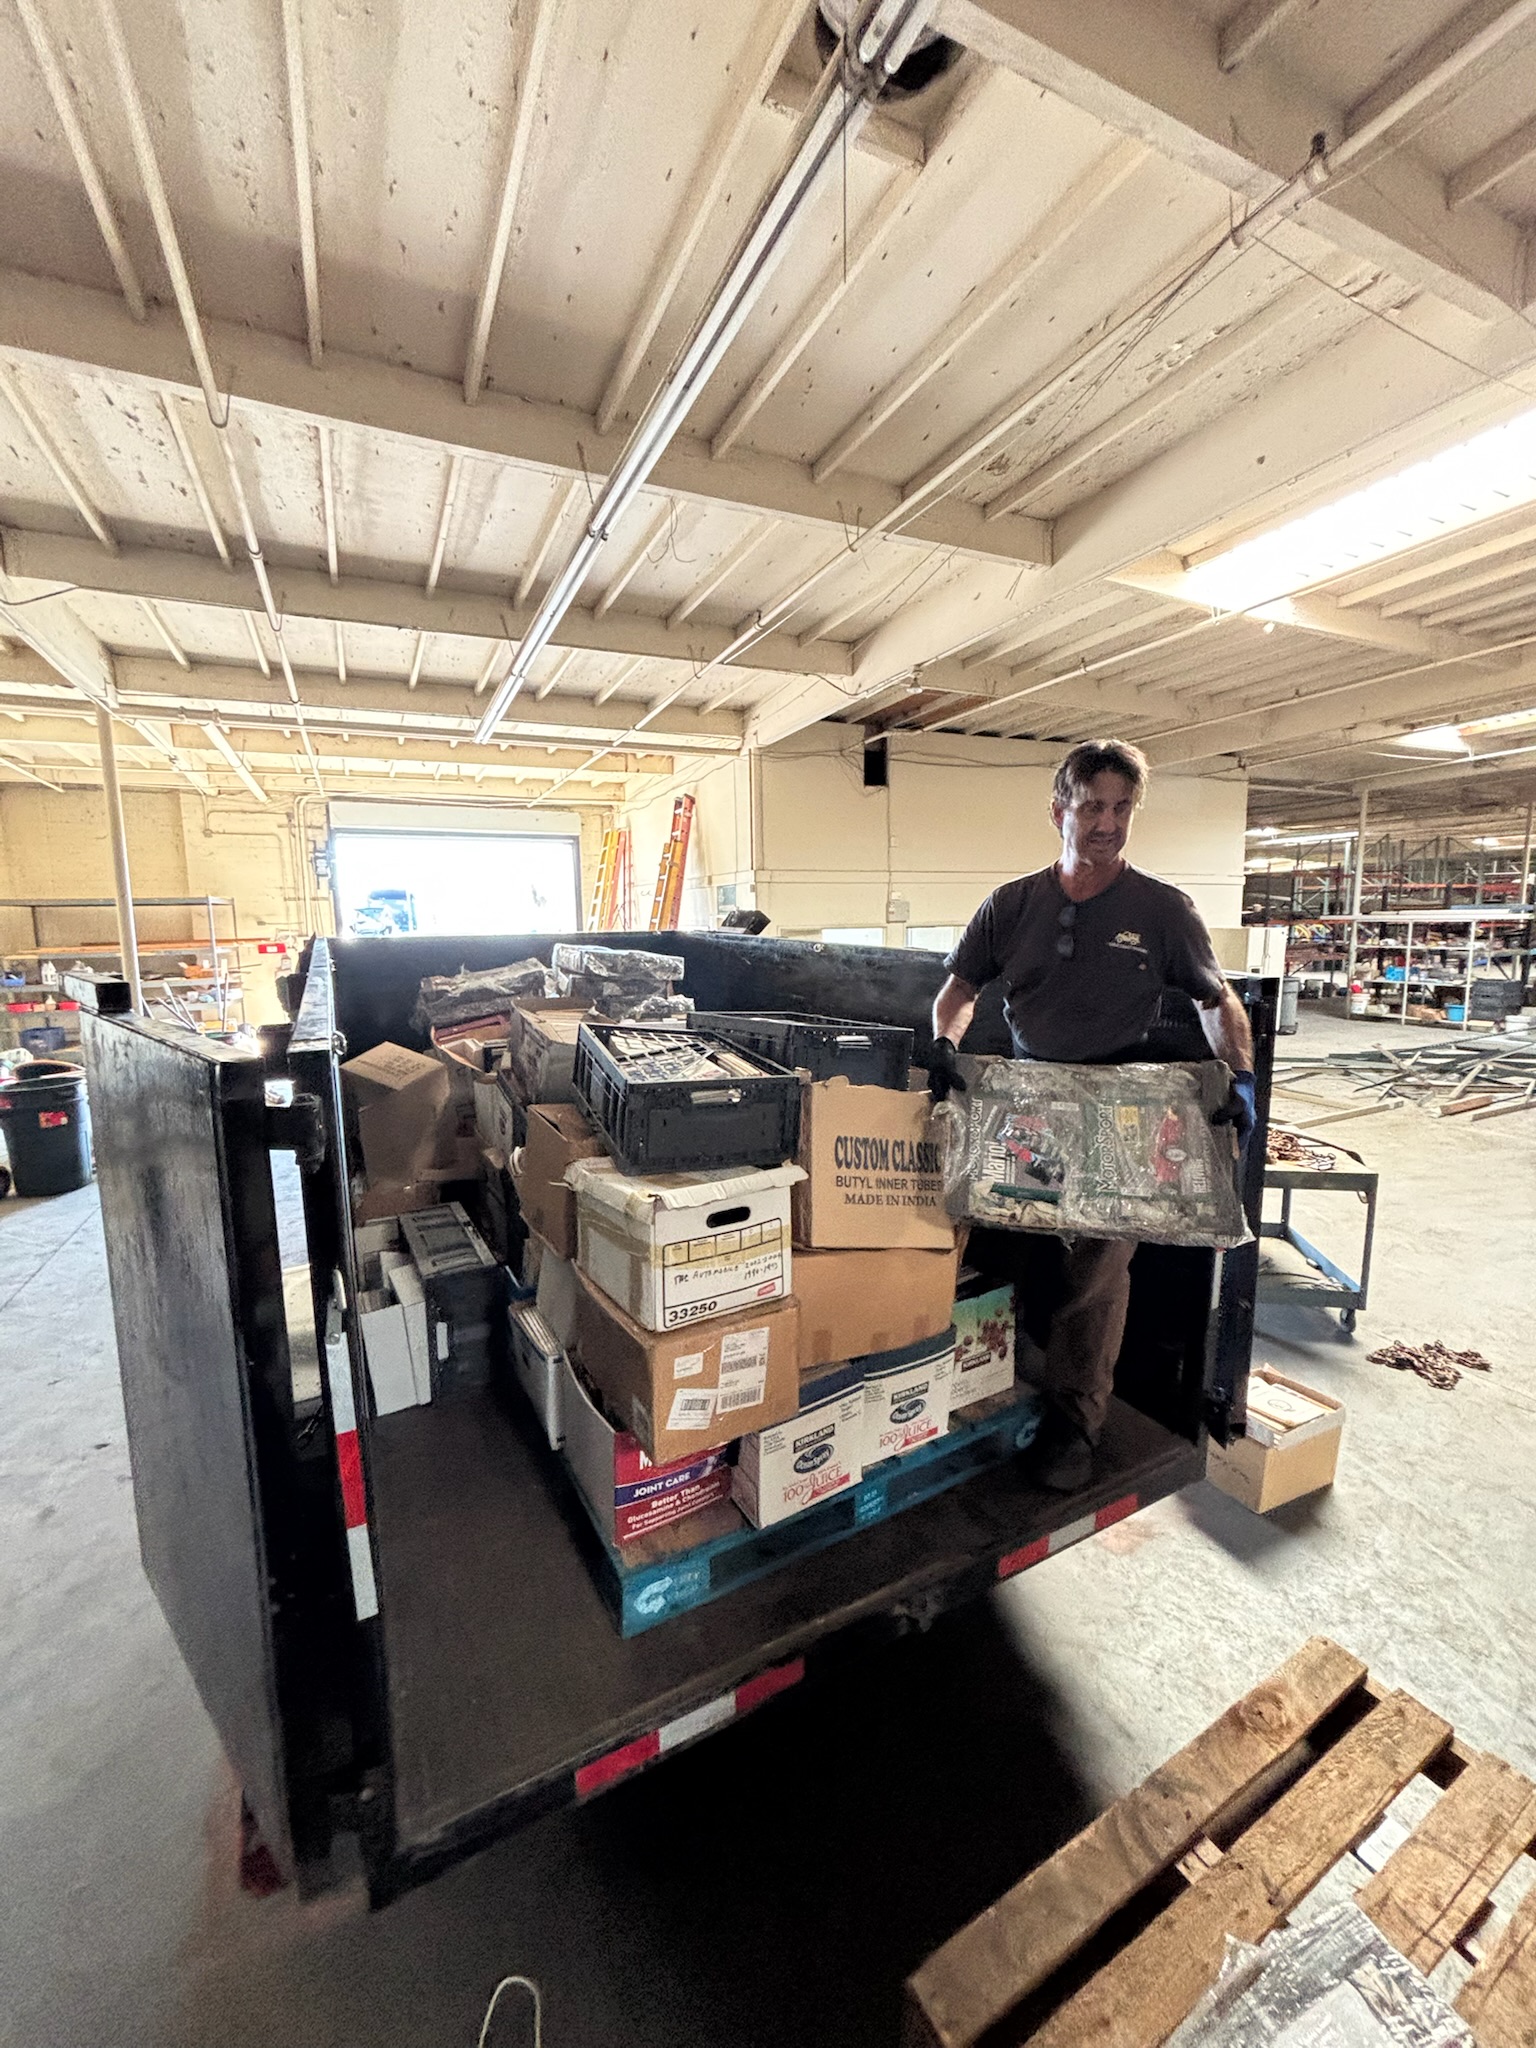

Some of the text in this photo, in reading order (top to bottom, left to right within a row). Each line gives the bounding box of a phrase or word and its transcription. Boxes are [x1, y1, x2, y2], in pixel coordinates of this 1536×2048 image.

[834, 1135, 890, 1172] CUSTOM
[836, 1175, 873, 1189] BUTYL
[876, 1177, 908, 1191] INNER
[844, 1193, 937, 1207] MADE IN INDIA
[668, 1301, 718, 1322] 33250
[633, 1472, 691, 1498] JOINT CARE
[651, 1484, 700, 1508] Better Than
